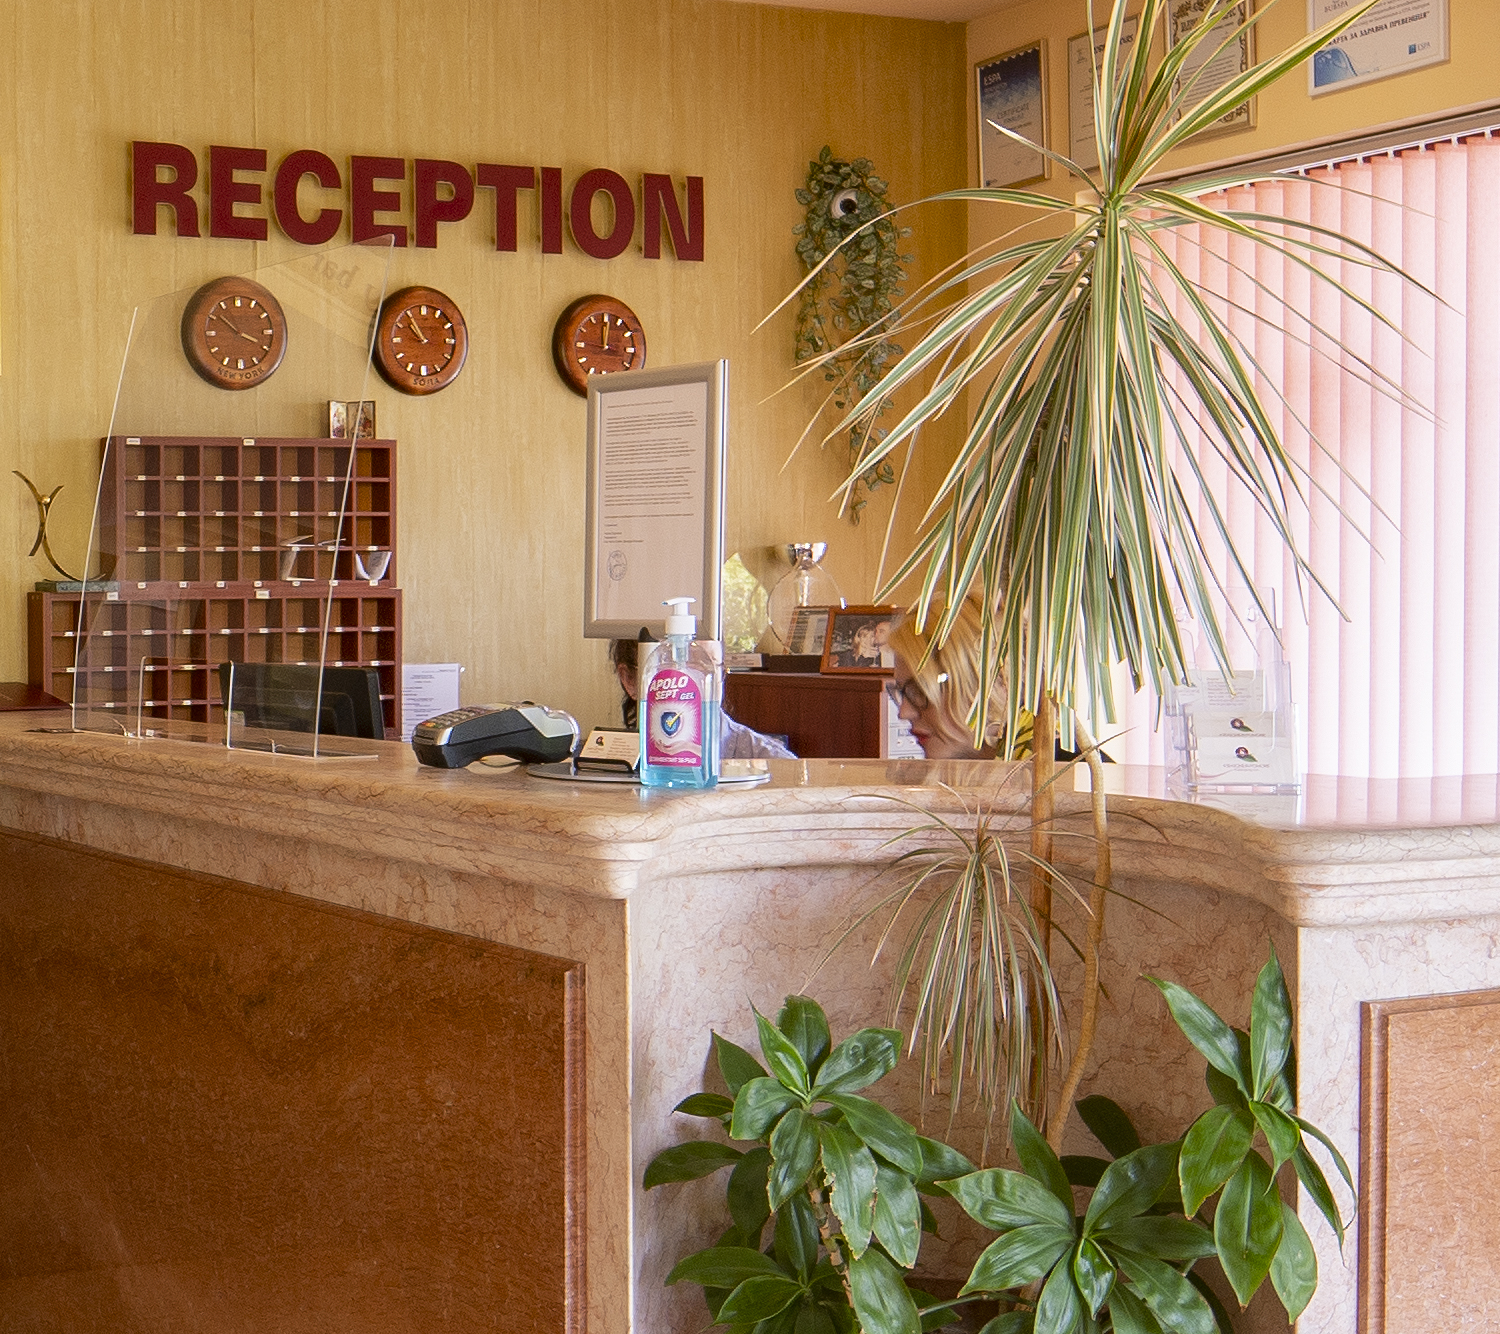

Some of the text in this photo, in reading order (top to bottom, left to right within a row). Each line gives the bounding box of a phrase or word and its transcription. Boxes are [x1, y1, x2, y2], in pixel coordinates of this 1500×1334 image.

[132, 141, 704, 262] RECEPTION
[217, 368, 235, 379] NEW
[650, 676, 688, 691] APOLO
[655, 689, 695, 700] SEPT GEL
